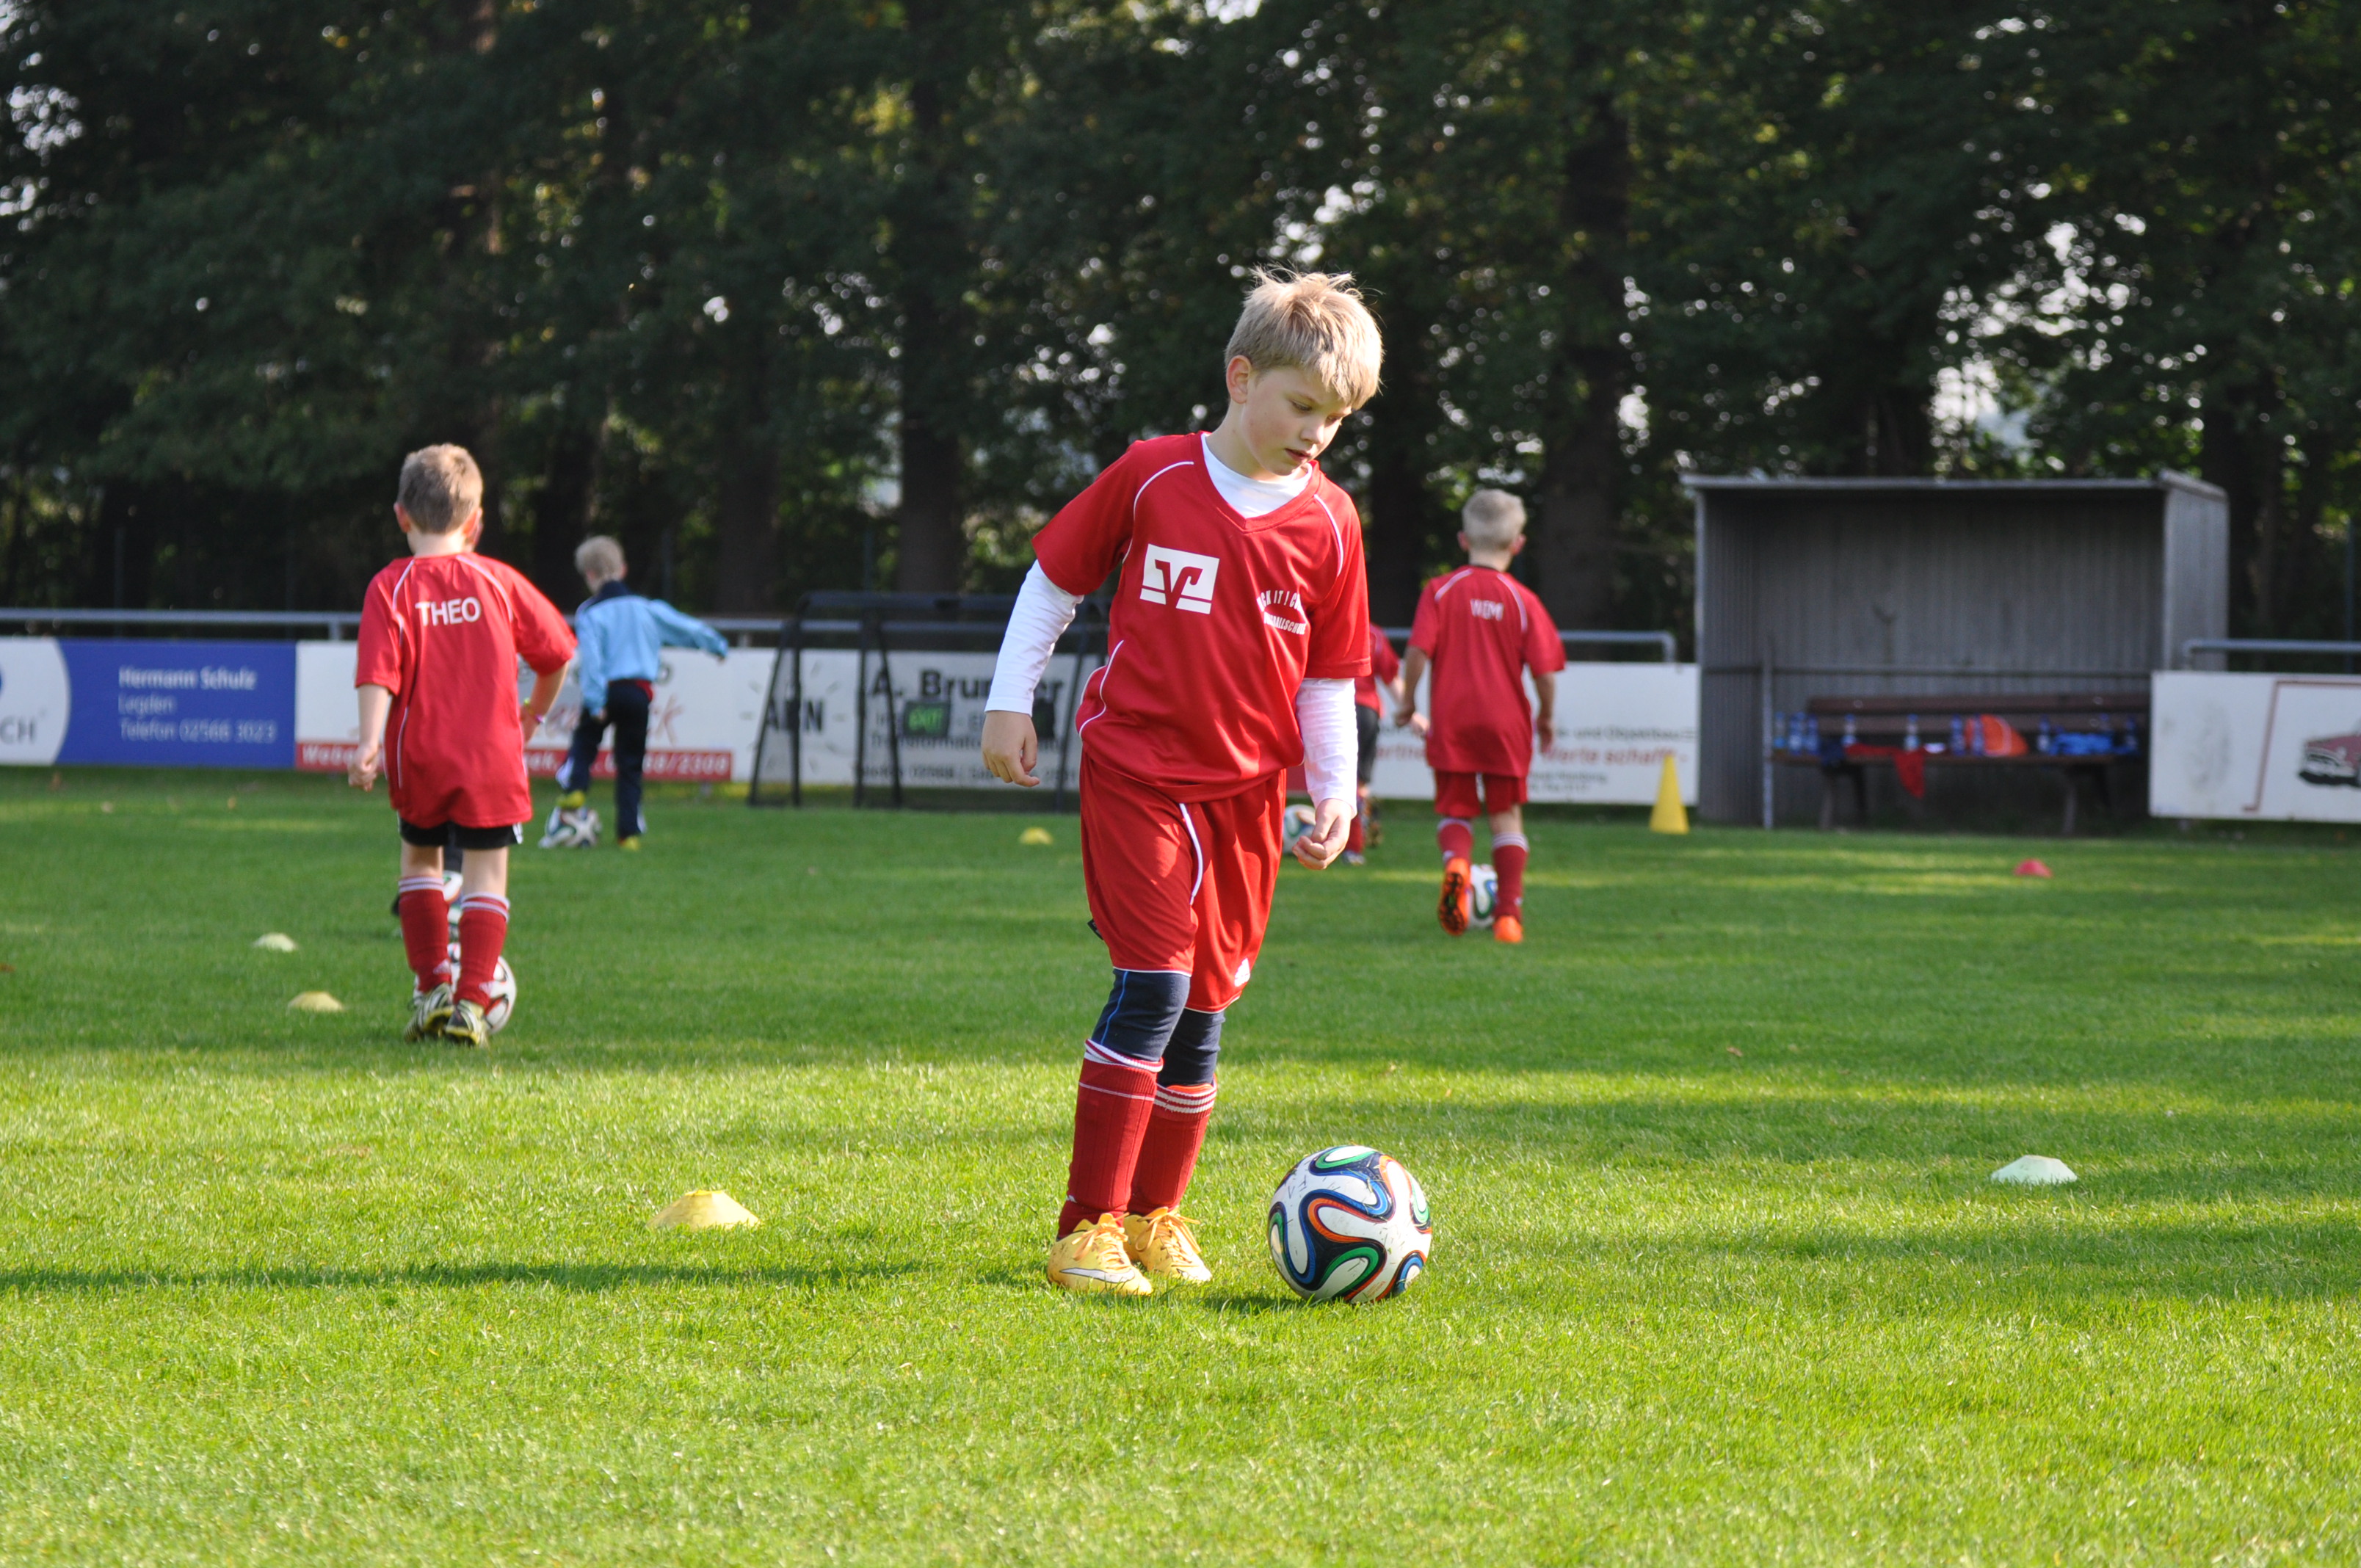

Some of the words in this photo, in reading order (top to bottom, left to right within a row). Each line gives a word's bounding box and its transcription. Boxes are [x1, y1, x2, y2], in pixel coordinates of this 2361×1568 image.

[415, 597, 481, 626] THEO
[119, 666, 197, 689] Hermann
[921, 669, 1063, 697] Bruer
